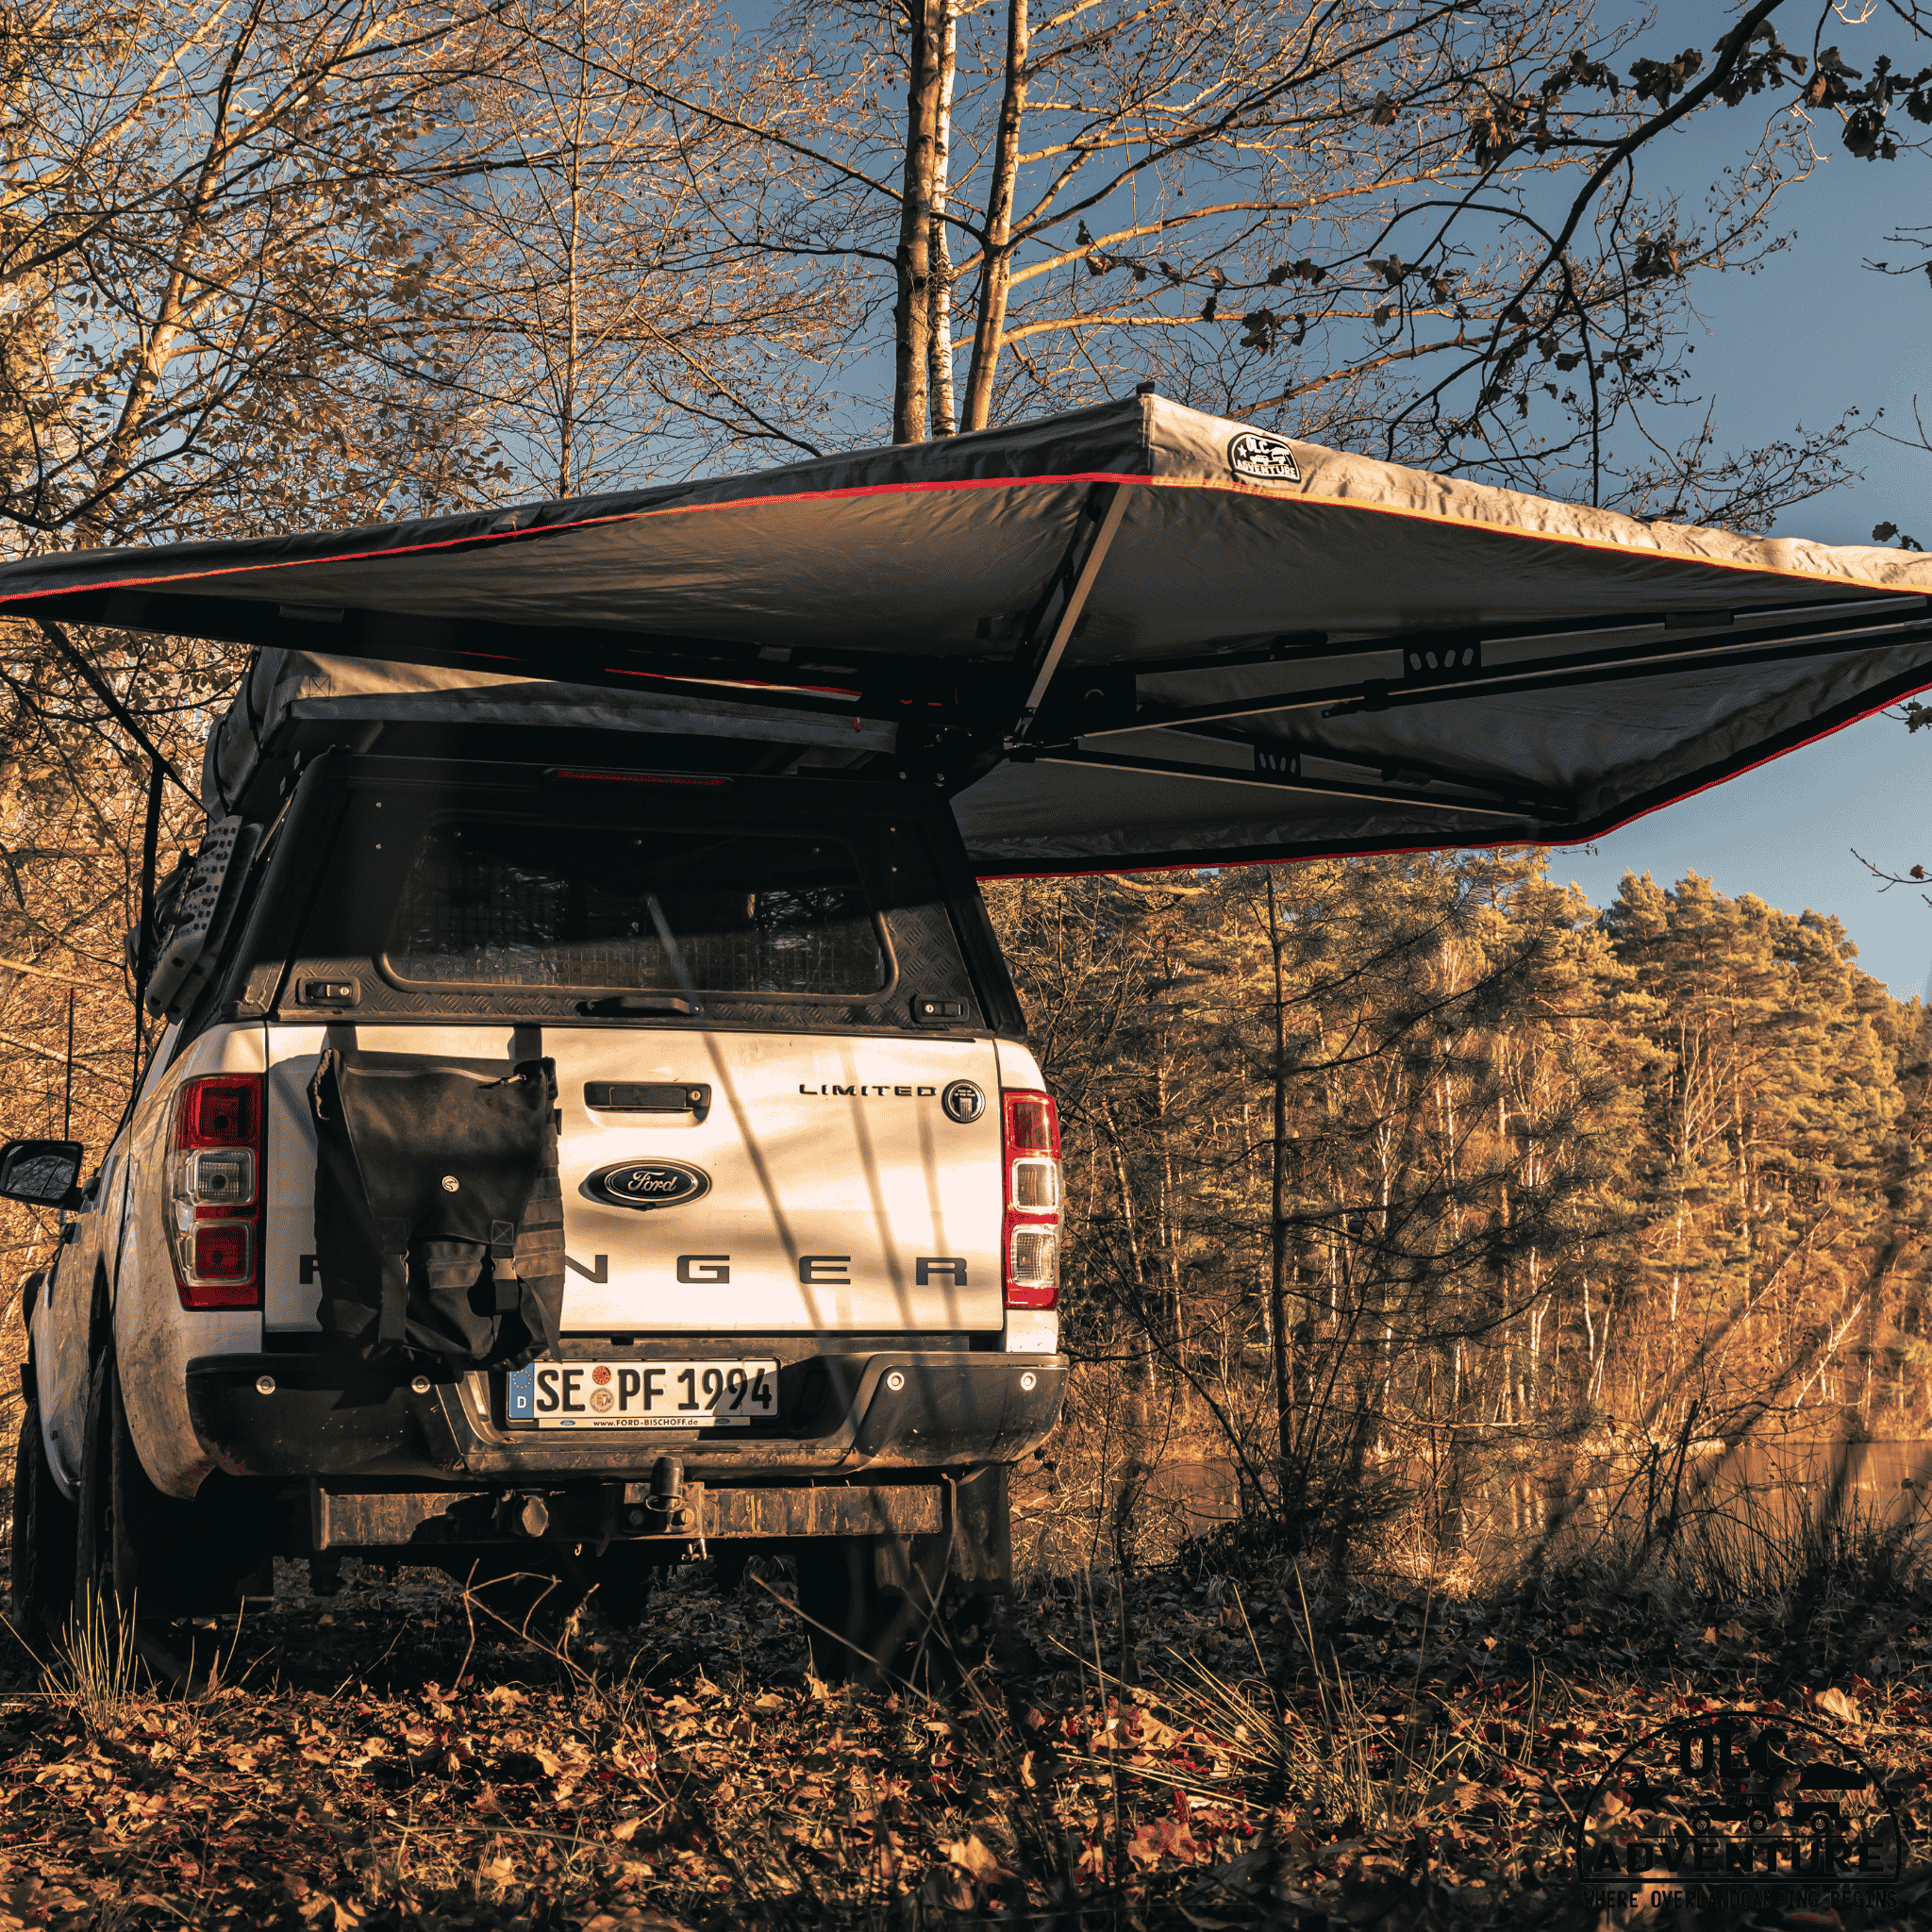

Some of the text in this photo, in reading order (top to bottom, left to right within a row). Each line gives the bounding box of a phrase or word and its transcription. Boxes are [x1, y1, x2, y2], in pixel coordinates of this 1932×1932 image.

[799, 1084, 937, 1096] LIMITED
[627, 1170, 677, 1191] Ford
[299, 1254, 968, 1286] NGER
[536, 1369, 586, 1412] SE
[618, 1368, 666, 1411] PF
[676, 1368, 773, 1410] 1994
[517, 1395, 527, 1409] D
[592, 1418, 698, 1427] www.FORD-BISCHOFF.de
